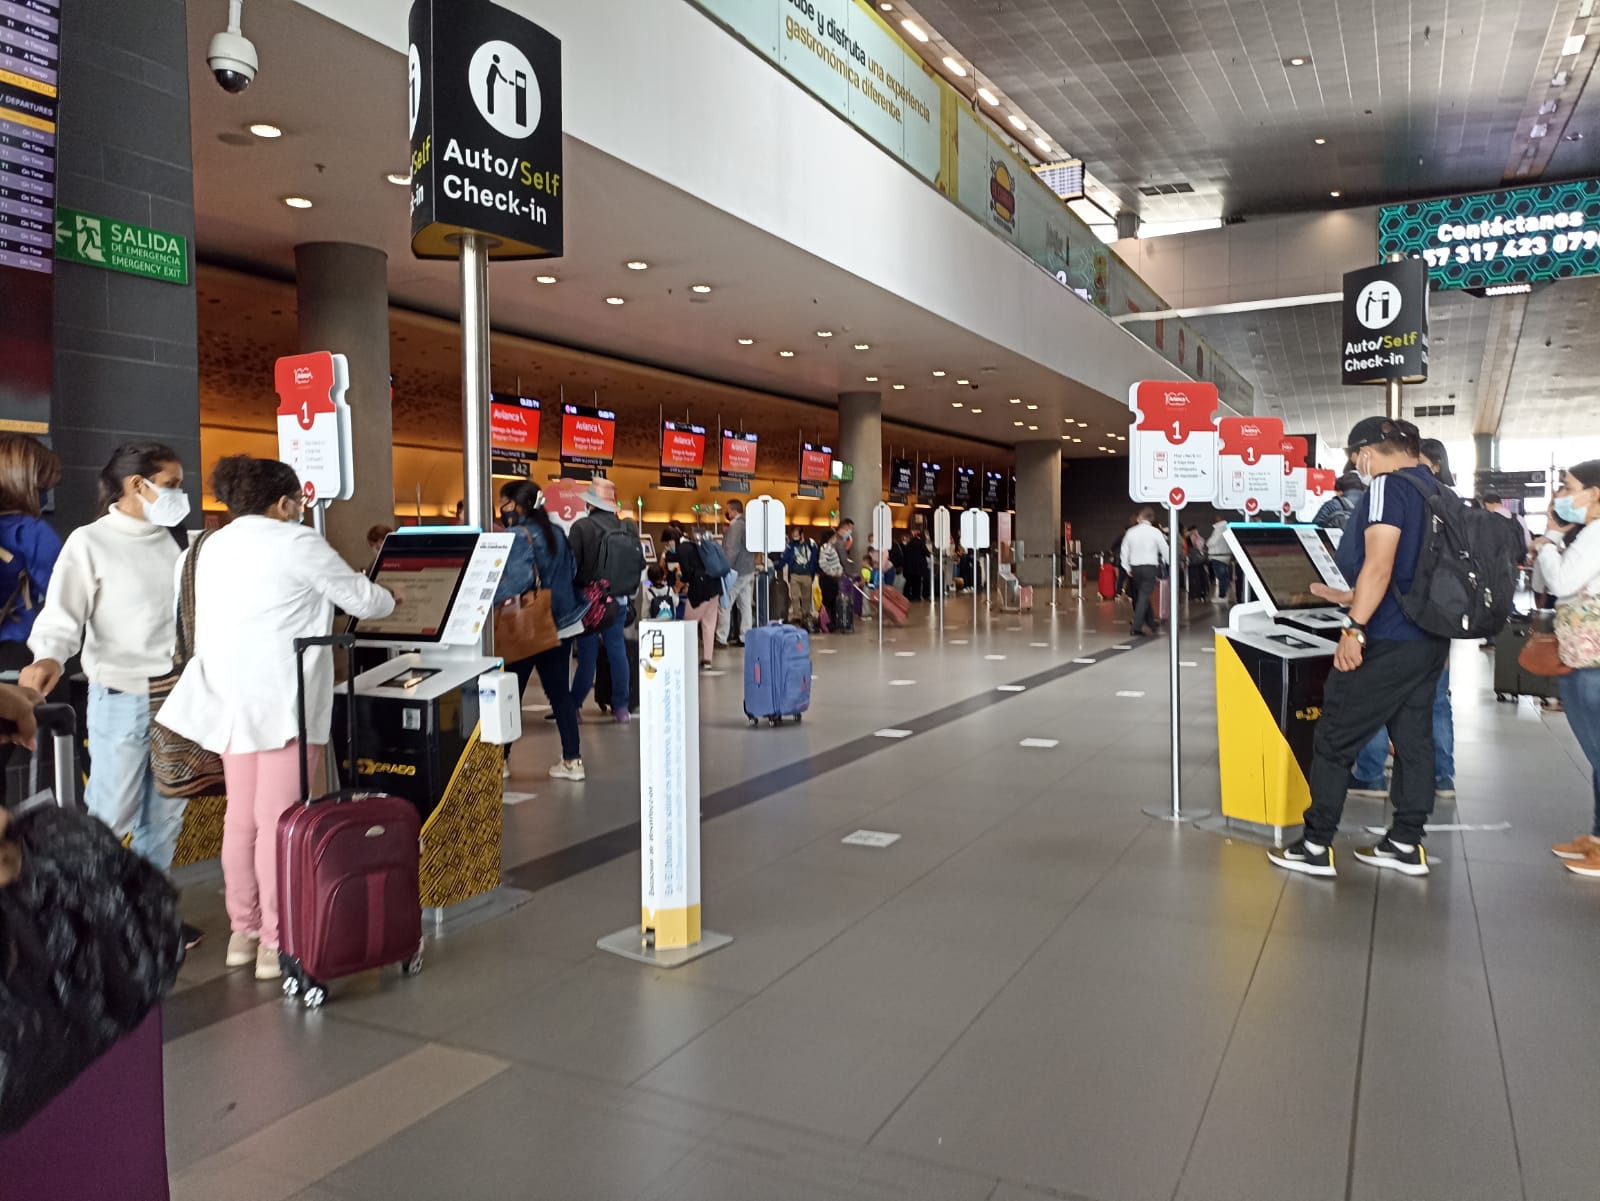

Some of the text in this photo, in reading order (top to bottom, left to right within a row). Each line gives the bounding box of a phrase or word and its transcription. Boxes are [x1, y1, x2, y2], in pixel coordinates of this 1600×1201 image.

[786, 15, 860, 88] gastronómica
[818, 11, 824, 36] y
[827, 18, 866, 66] disfruta
[868, 56, 884, 82] una
[887, 73, 930, 123] experiencia
[5, 95, 53, 117] DEPARTURES
[443, 138, 560, 198] Auto/Self
[443, 174, 547, 225] Check-in
[1438, 211, 1583, 242] Contáctanos
[111, 224, 180, 256] SALIDA
[1455, 242, 1498, 264] 317
[1503, 237, 1547, 259] 423
[1553, 230, 1600, 253] 079
[111, 243, 180, 265] DE EMERGENCIA
[111, 255, 181, 278] EMERGENCY EXIT
[1345, 331, 1418, 356] Auto/Self
[1345, 352, 1405, 372] Check-in
[301, 401, 310, 424] 1
[576, 421, 598, 432] Avianca
[1172, 420, 1182, 440] 1
[1246, 446, 1255, 462] 1
[512, 463, 527, 474] 142
[564, 505, 572, 519] 2
